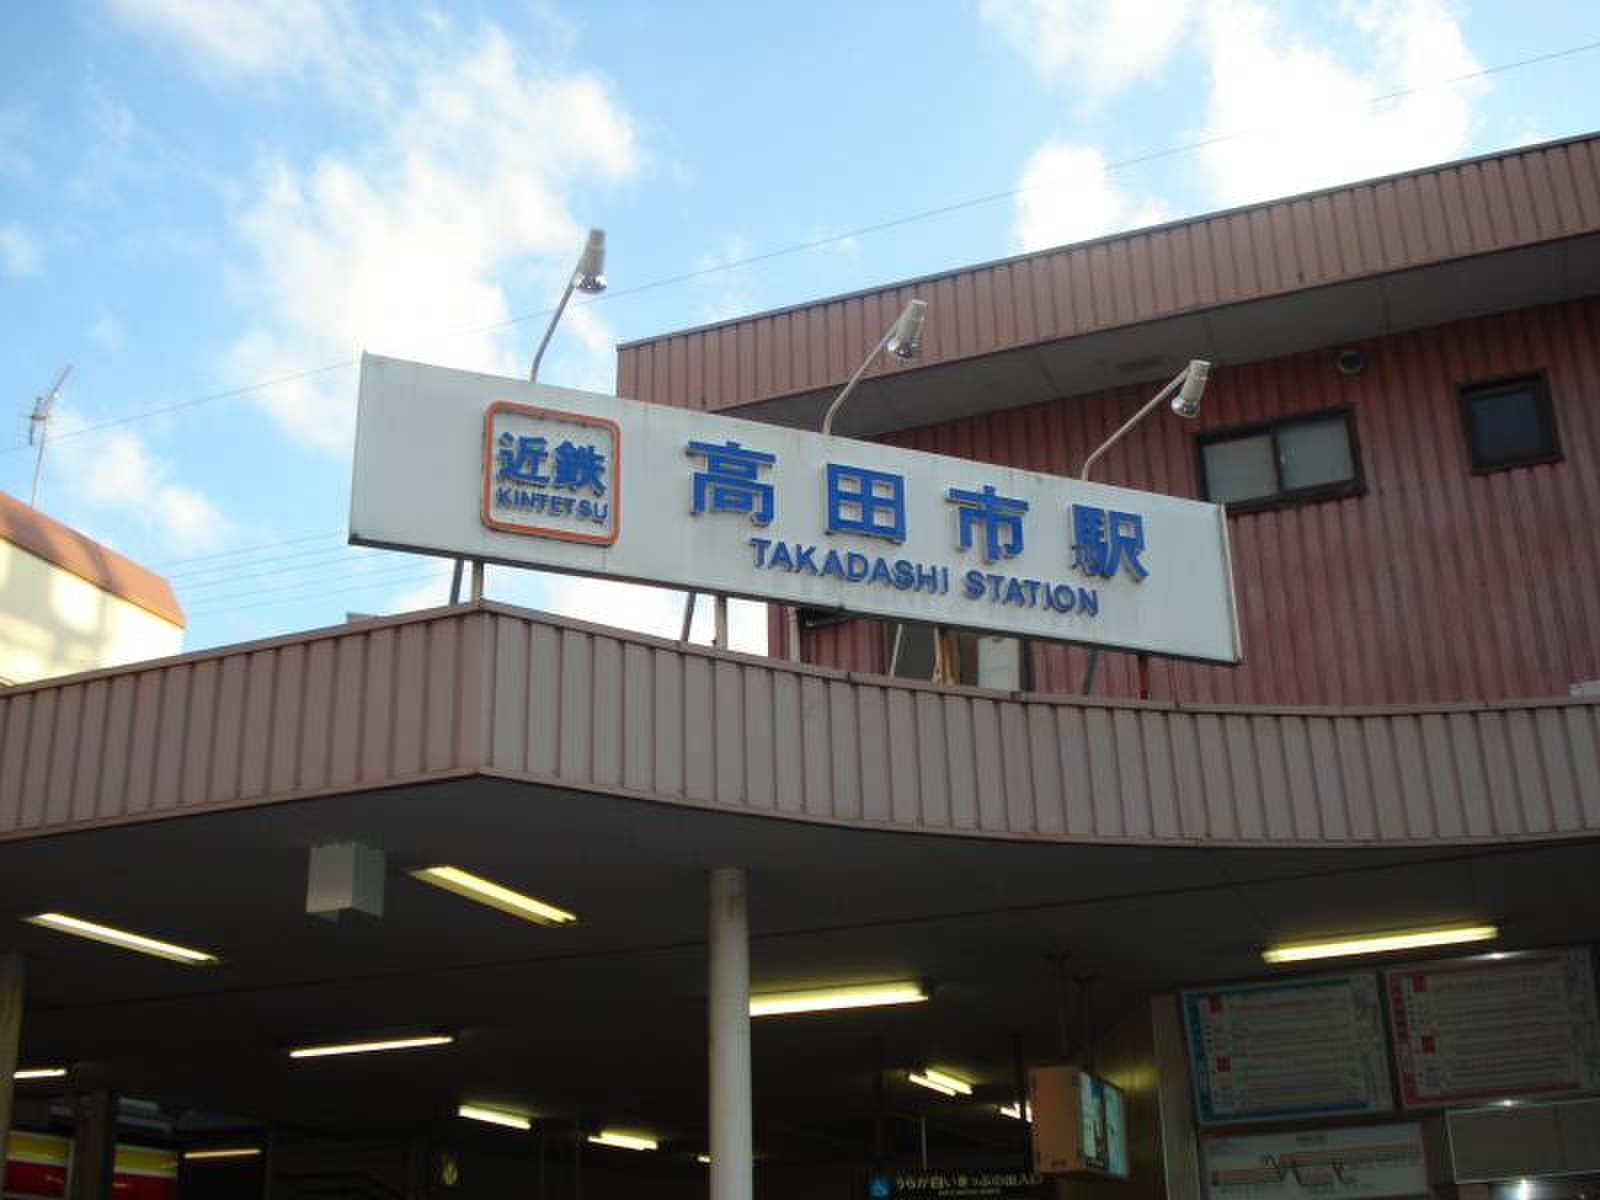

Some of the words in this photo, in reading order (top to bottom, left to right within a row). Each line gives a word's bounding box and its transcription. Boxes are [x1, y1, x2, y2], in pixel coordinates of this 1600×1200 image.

[497, 431, 606, 496] 近鉄
[496, 487, 608, 521] KINTETSU
[687, 441, 1150, 582] 高田市駅
[749, 538, 949, 595] TAKADASHI
[964, 570, 1100, 617] STATION
